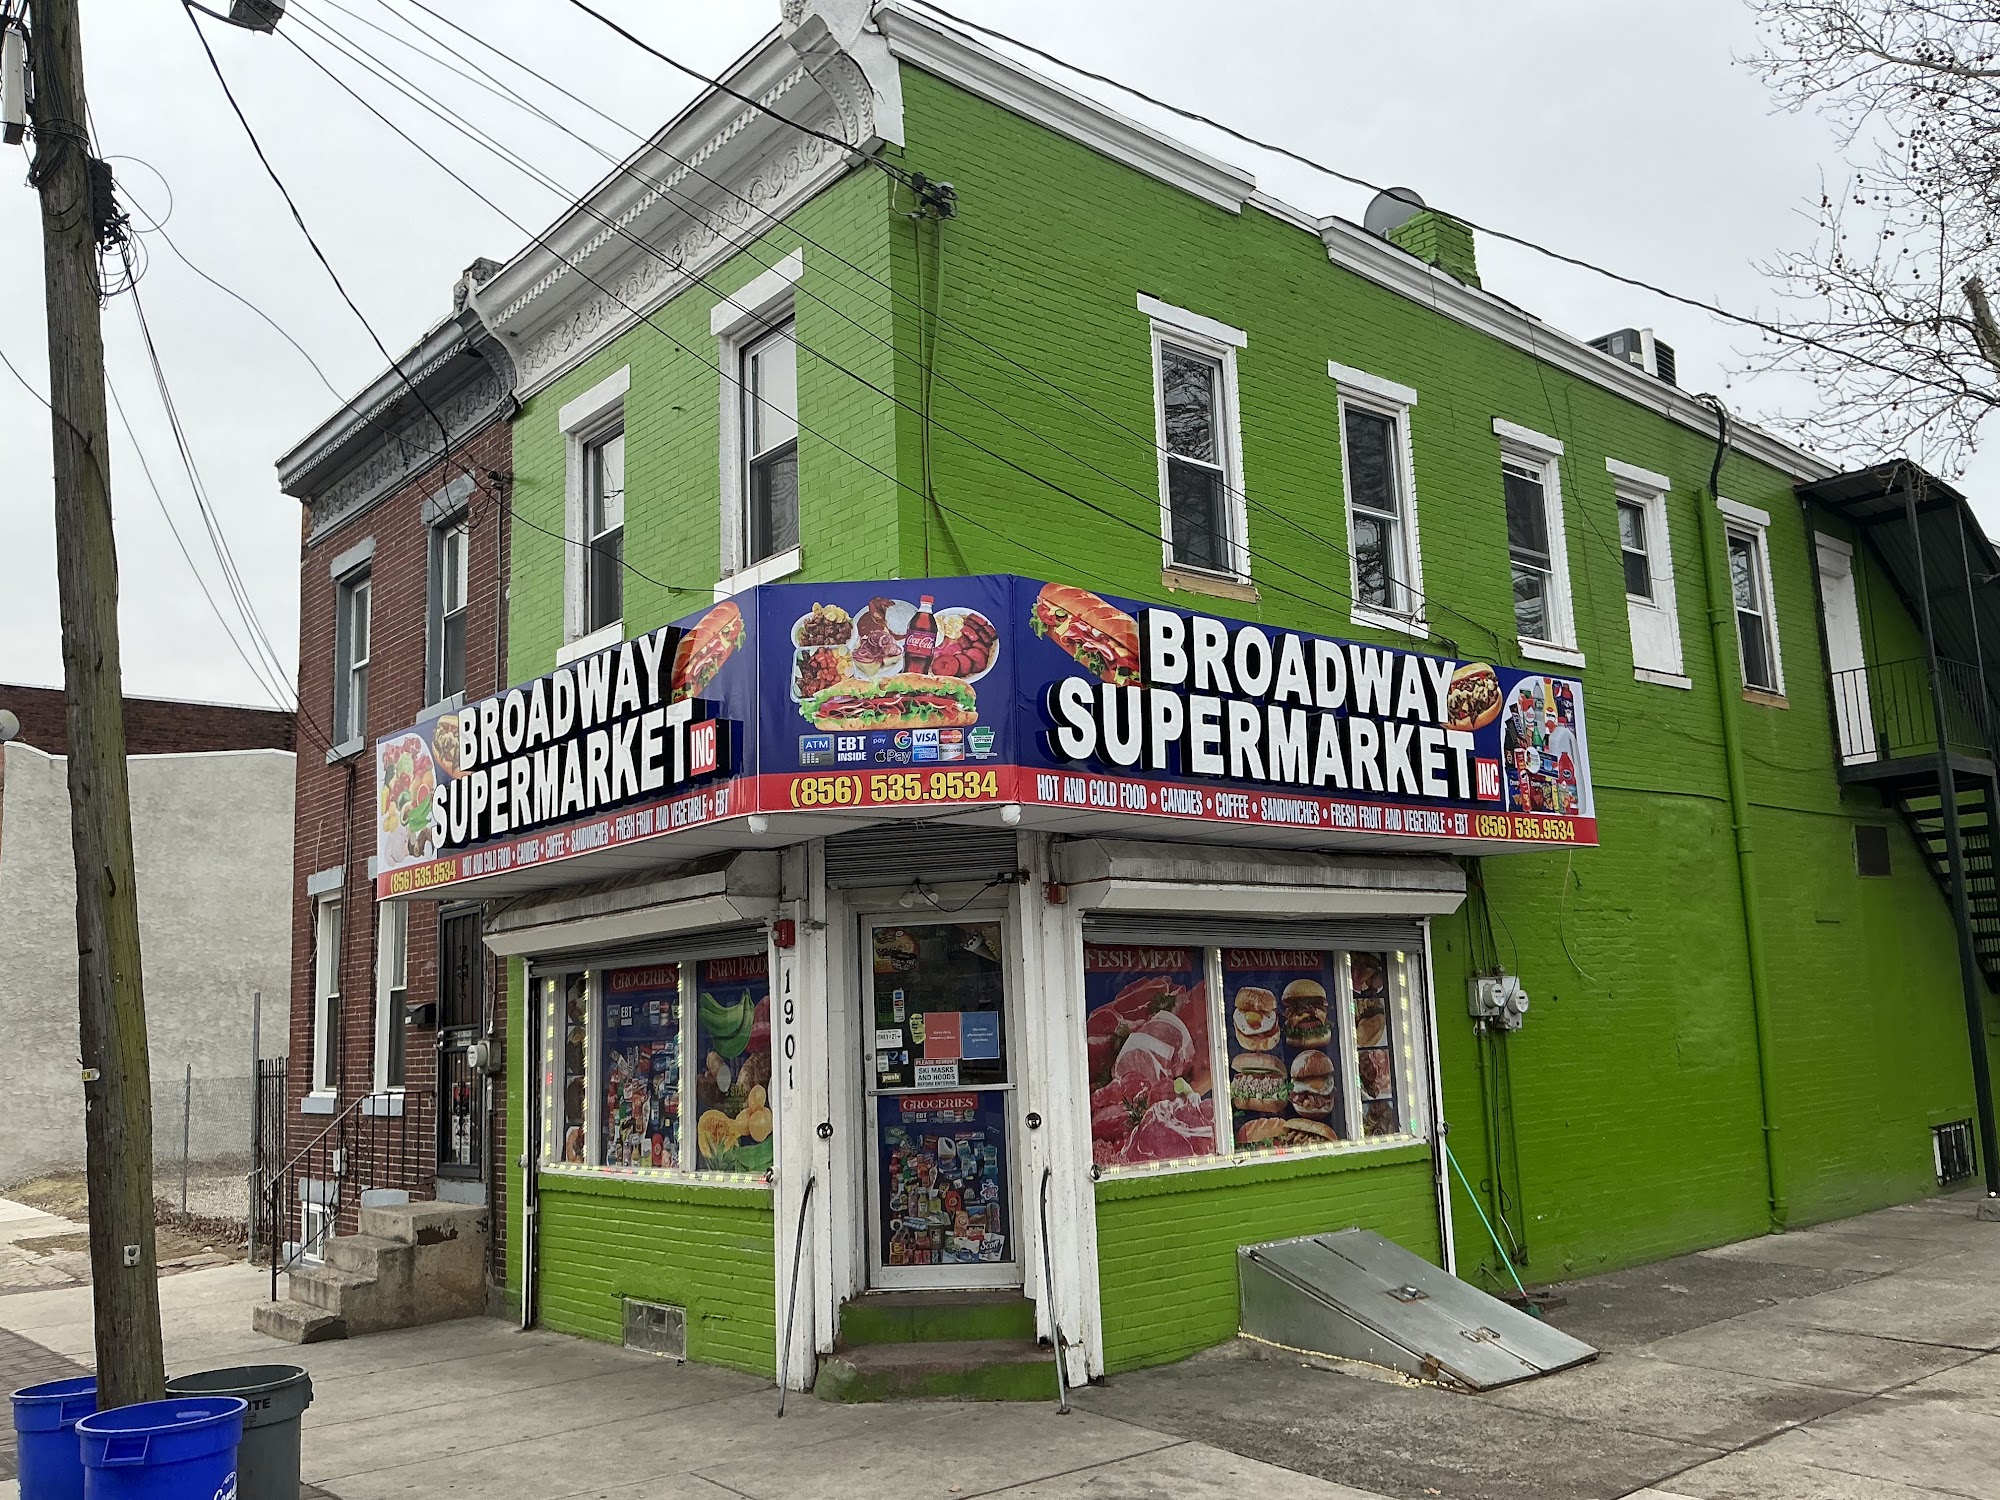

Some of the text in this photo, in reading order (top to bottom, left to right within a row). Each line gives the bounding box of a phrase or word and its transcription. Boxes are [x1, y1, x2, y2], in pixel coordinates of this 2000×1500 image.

[1147, 608, 1455, 723] BROADWAY
[458, 627, 669, 771] BROADWAY
[805, 740, 828, 749] ATM
[837, 735, 867, 751] EBT
[915, 733, 937, 742] VISA
[1057, 676, 1499, 799] SUPERMARKET INC
[837, 752, 867, 762] INSIDE
[886, 749, 912, 764] Pay
[431, 698, 714, 849] SUPERMARKET INC
[790, 771, 998, 807] (856) 535.9534
[1036, 773, 1575, 841] HOT AND COLD FOOD CANDIES COFFEE SANDWICHES FRESH FRUIT AND VEGETABLE EBT (856) 535.9534
[390, 788, 730, 894] (856) 535.9534 HOT AND COLD FOOD CANDIES COFFEE SANDWICHES FRESH FRUIT AND VEGETABLE EBT
[1138, 947, 1185, 969] MEAT
[1230, 949, 1319, 968] SANDWICHES
[612, 968, 676, 991] GROCERIES
[709, 960, 736, 980] FARM
[621, 1006, 632, 1018] EBT
[882, 1073, 900, 1082] push
[902, 1098, 973, 1110] GROCERIES
